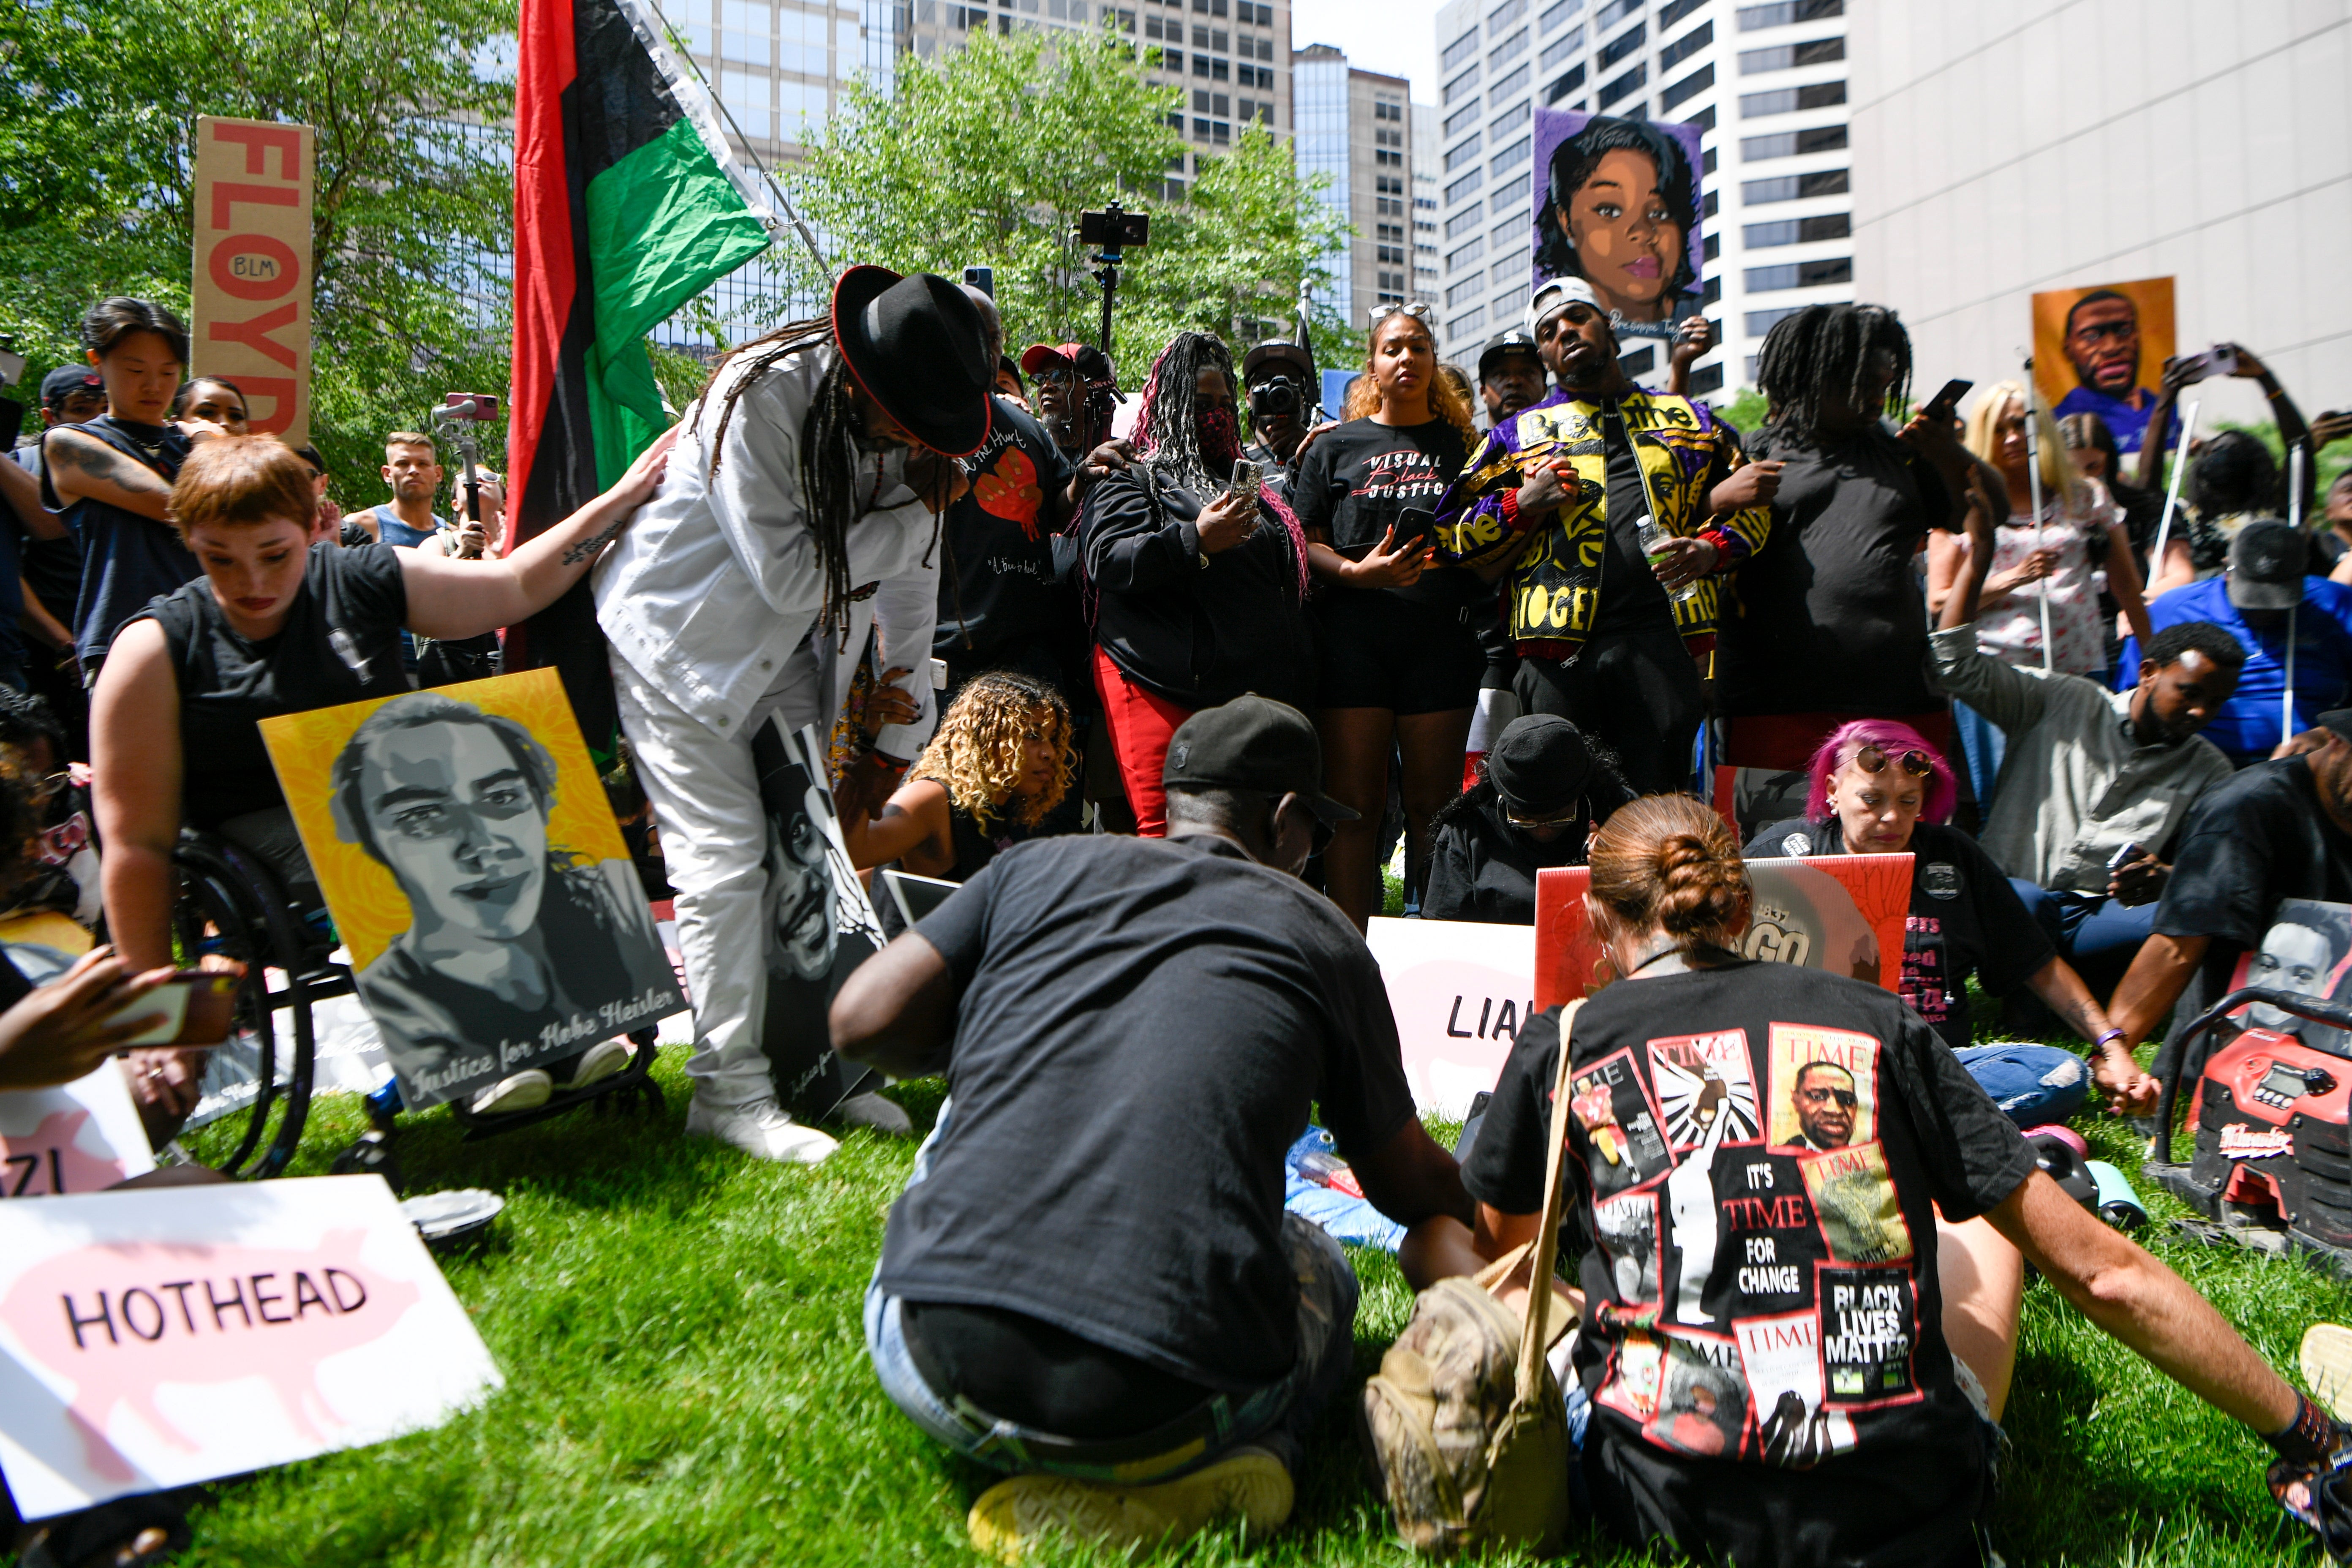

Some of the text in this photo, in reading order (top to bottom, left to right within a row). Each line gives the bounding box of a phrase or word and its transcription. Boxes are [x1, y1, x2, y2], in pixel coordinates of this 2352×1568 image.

[208, 123, 299, 436] FLOYD
[234, 257, 274, 277] BLM
[1662, 318, 1684, 343] Tay
[988, 426, 1026, 449] Hurt
[1370, 452, 1441, 470] VISUAL
[1368, 482, 1451, 500] JUSTIC
[1906, 916, 1941, 934] ers
[1744, 922, 1810, 967] GO
[411, 1046, 495, 1101] Justice
[500, 1039, 534, 1073] for
[599, 987, 675, 1029] Heisler
[1655, 1037, 1740, 1069] TIME
[1782, 1037, 1867, 1074] TIME
[2219, 1122, 2294, 1149] Milwaukee
[0, 1148, 64, 1197] ZI
[1745, 1162, 1774, 1190] IT'S
[1809, 1148, 1876, 1181] TIME
[1721, 1195, 1807, 1231] TIME
[1745, 1237, 1776, 1265] FOR
[1738, 1266, 1800, 1294] CHANGE
[61, 1268, 367, 1348] HOTHEAD
[1833, 1285, 1903, 1313] BLACK
[1740, 1323, 1818, 1353] TIME
[1839, 1309, 1901, 1339] LIVES
